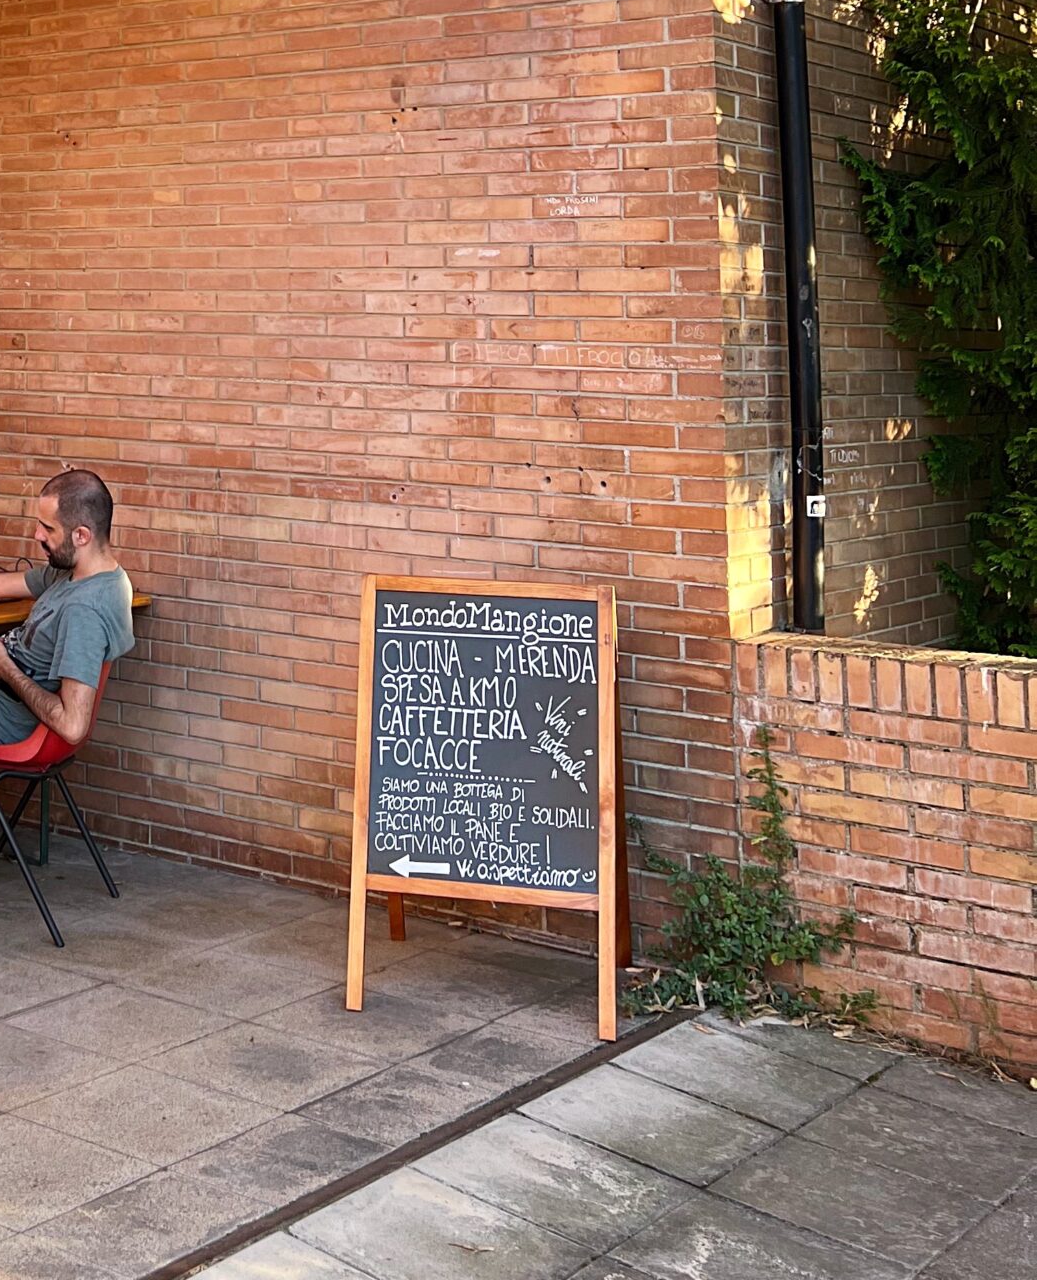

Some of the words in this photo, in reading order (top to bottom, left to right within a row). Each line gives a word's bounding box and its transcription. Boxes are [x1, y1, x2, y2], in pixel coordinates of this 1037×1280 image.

[382, 601, 593, 646] MondoMangione
[381, 639, 464, 678] CUCINA
[494, 643, 597, 684] MERENDA
[380, 674, 446, 705] SPESA
[450, 677, 465, 706] A
[379, 704, 527, 740] CAFFETTERIA
[540, 696, 576, 737] Vini
[376, 736, 482, 773] FOCACCE
[536, 730, 587, 782] naturali
[382, 777, 420, 794] SIAMO
[425, 780, 449, 795] UNA
[453, 782, 503, 800] BOTTEGA
[510, 786, 526, 803] DI
[378, 794, 436, 814] PRODOTTI
[489, 803, 513, 822] BIO
[518, 806, 527, 822] E
[374, 832, 465, 856] COLTIVIAMO
[375, 811, 444, 832] FACCIAMO
[450, 820, 460, 836] IL
[465, 819, 503, 843] PANE
[509, 823, 521, 843] E
[456, 858, 475, 878] Vi
[477, 864, 581, 887] aspettiamo
